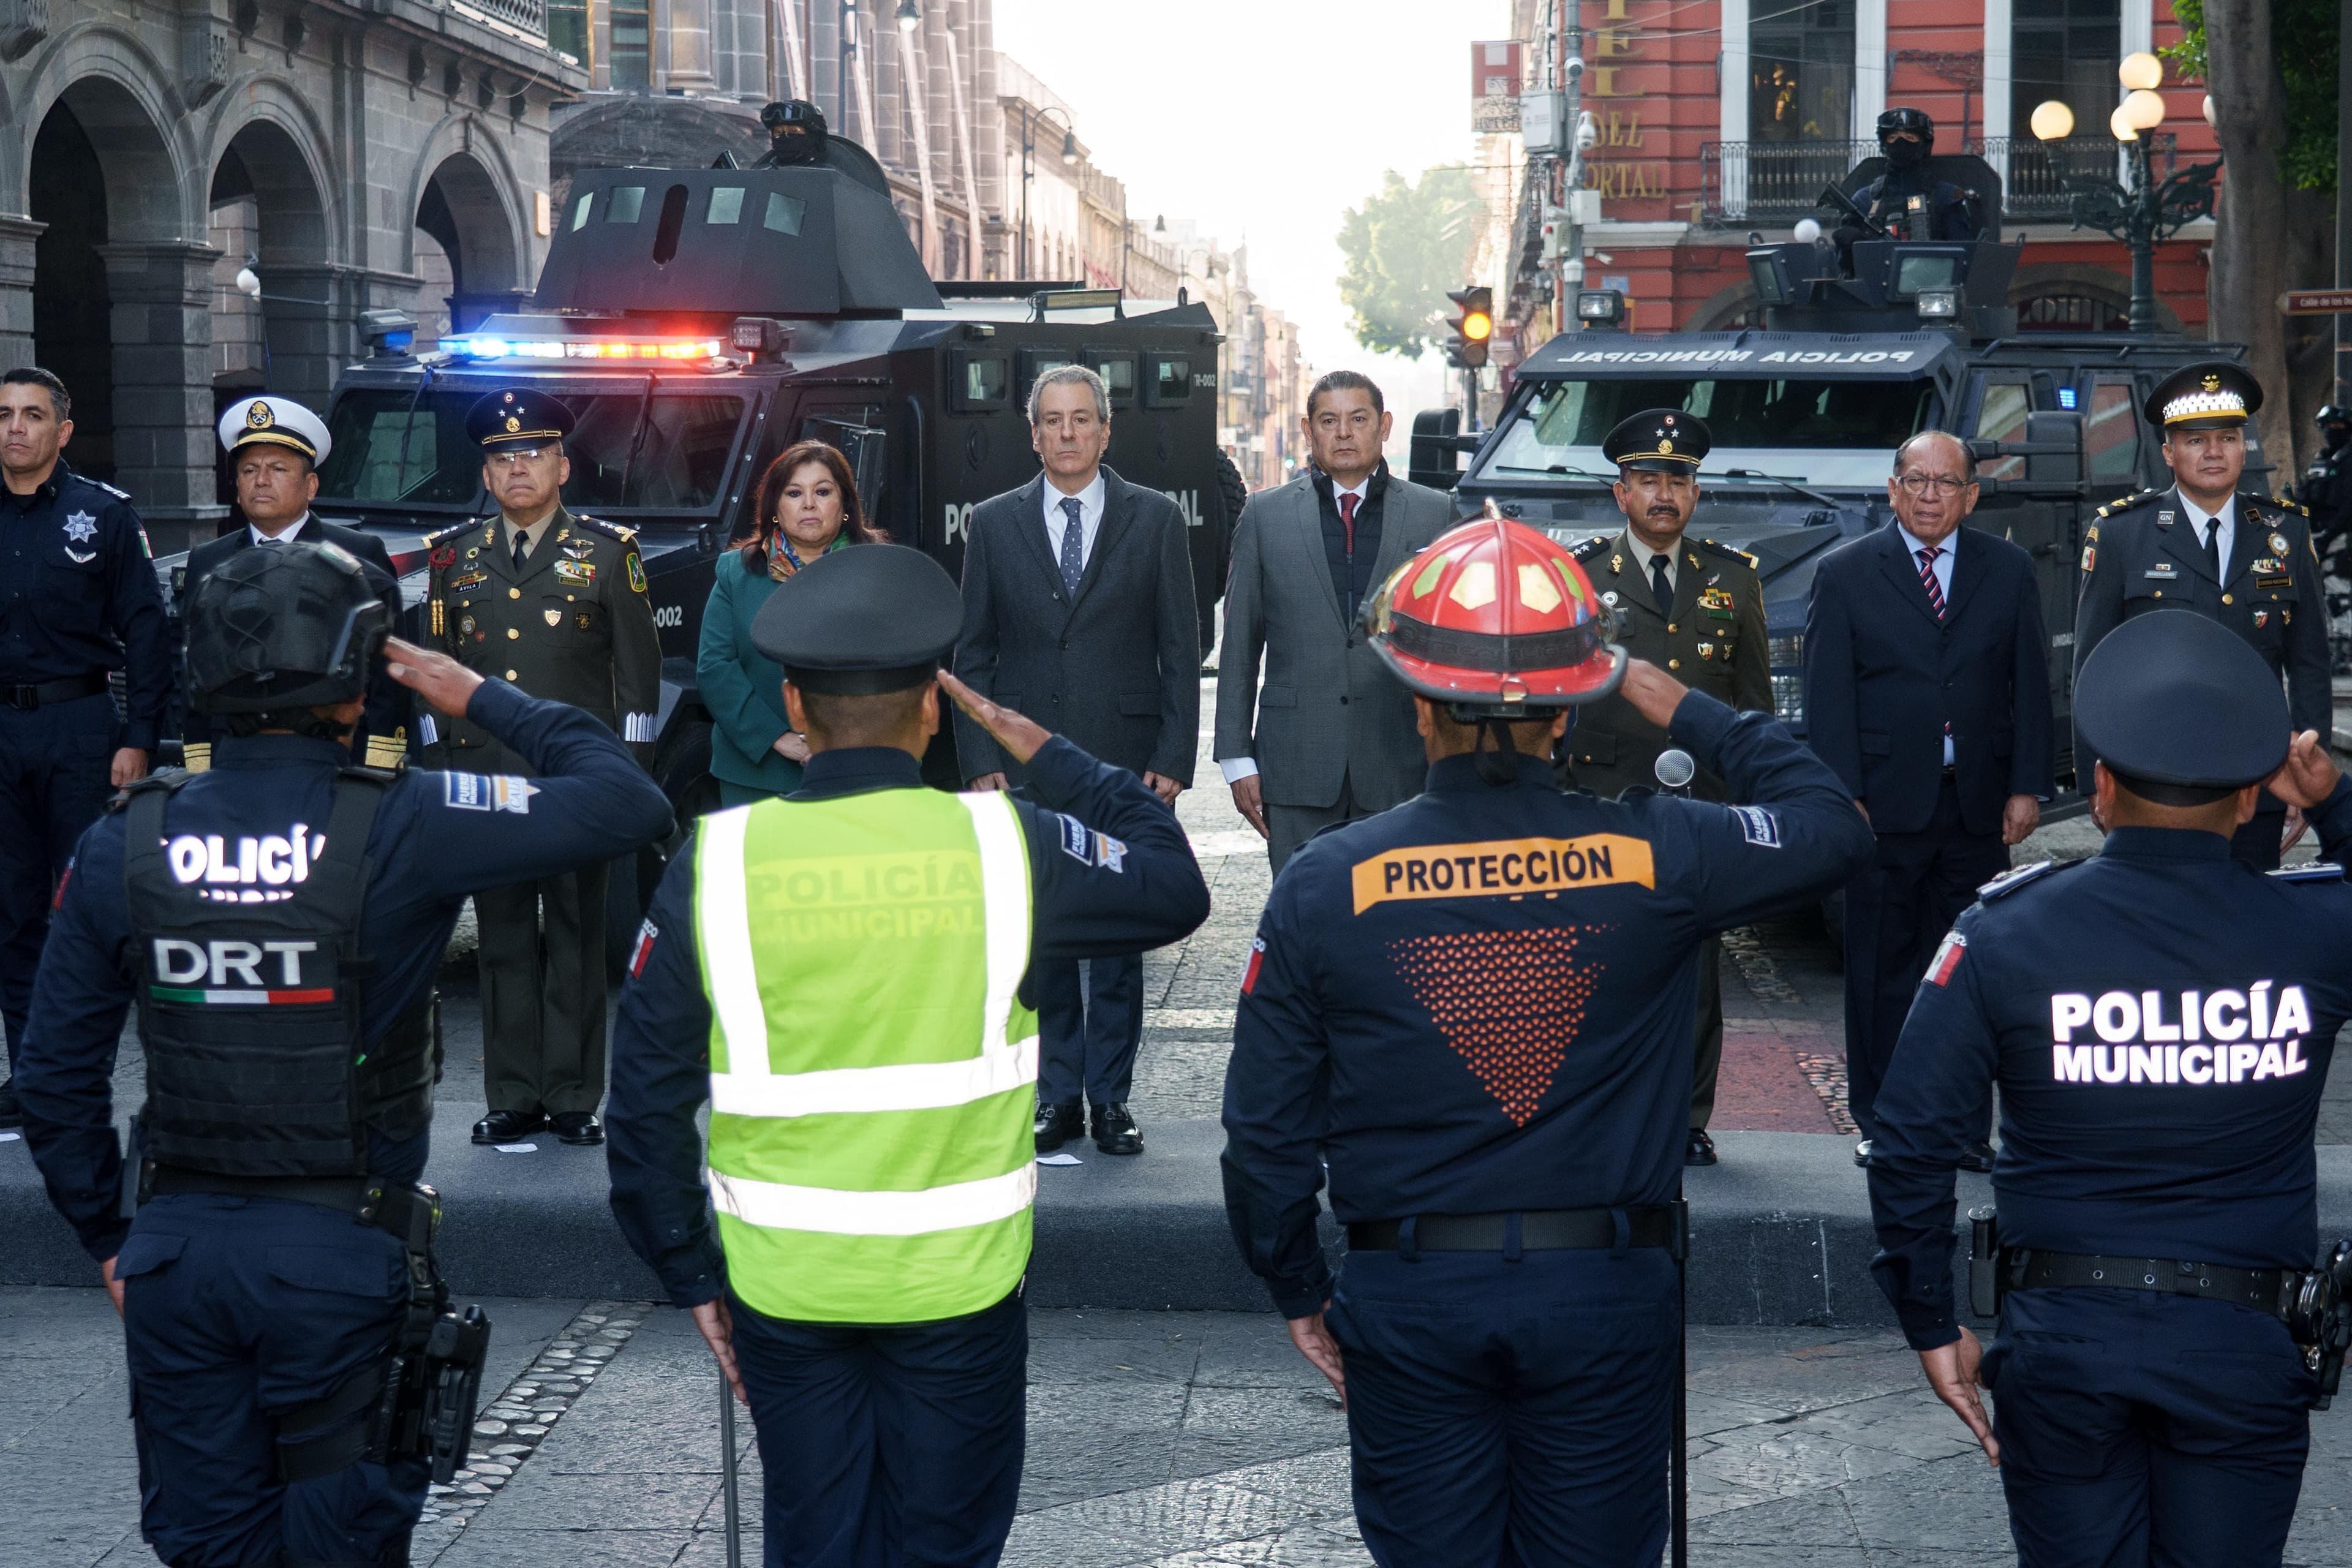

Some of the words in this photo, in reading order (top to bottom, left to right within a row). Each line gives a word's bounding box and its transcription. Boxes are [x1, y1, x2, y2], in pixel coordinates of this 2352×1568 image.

[1585, 162, 1667, 200] ORTAL
[459, 583, 477, 592] AVILA
[159, 823, 327, 885] OLICÍ
[1384, 843, 1613, 894] PROTECCIÓN
[748, 855, 982, 905] POLICÍA
[154, 940, 317, 986] DRT
[2051, 980, 2311, 1042] POLICÍA
[2052, 1039, 2309, 1084] MUNICIPAL
